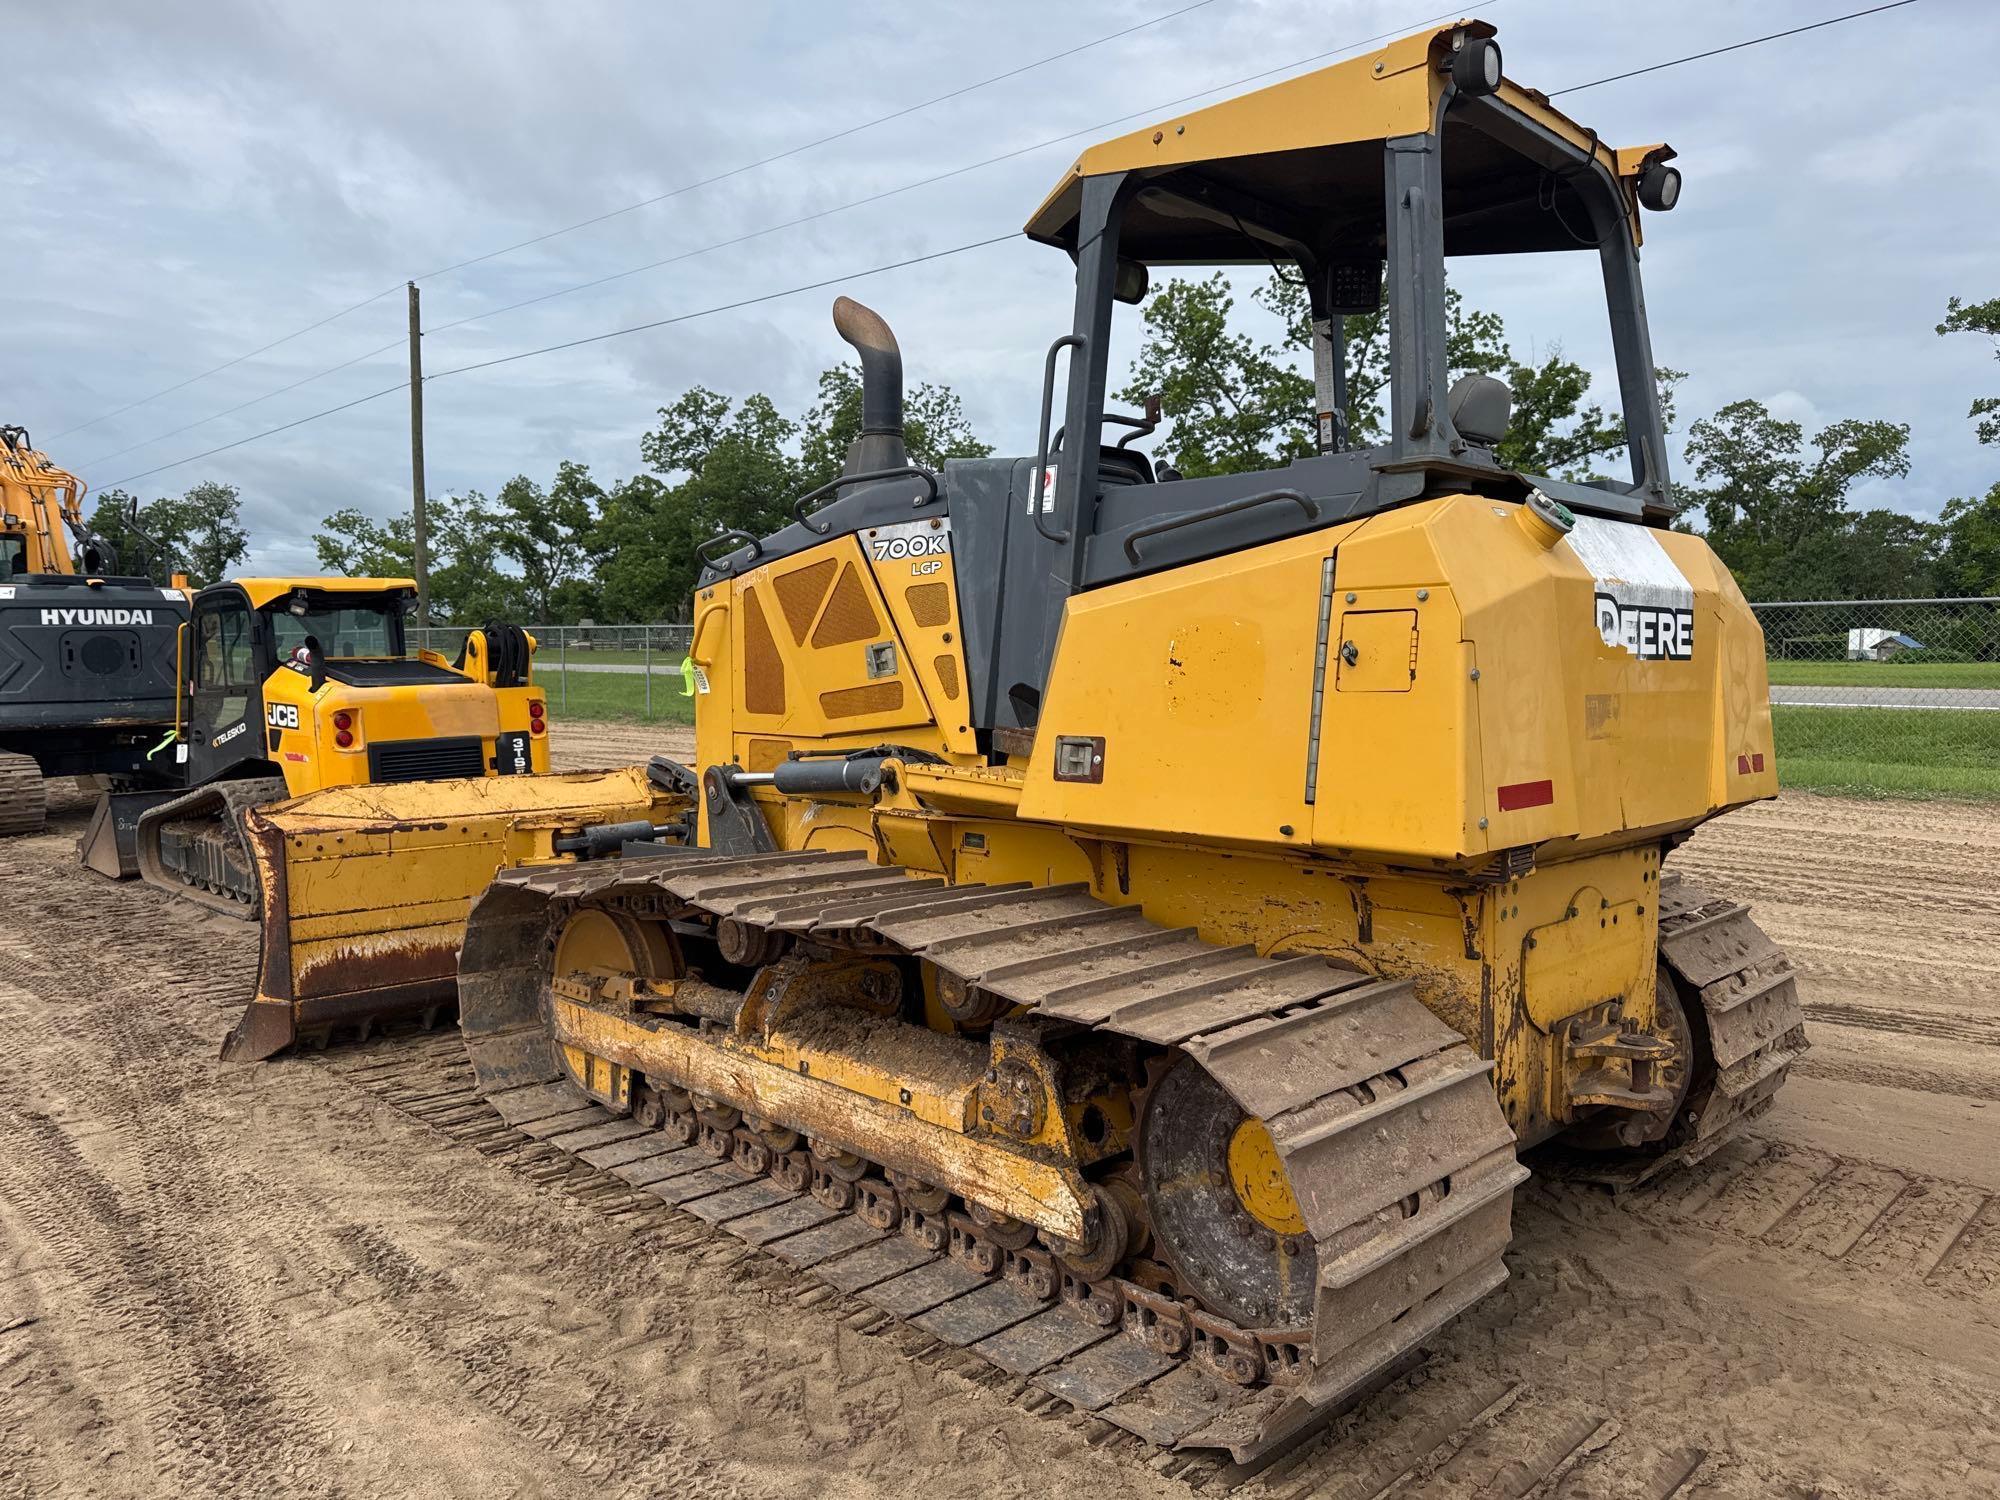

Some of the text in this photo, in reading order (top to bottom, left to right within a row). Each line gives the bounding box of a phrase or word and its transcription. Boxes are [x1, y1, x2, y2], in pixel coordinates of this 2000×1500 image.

[874, 534, 945, 561] 700K
[911, 561, 943, 576] LGP
[40, 609, 153, 625] HYUNDAI
[1595, 596, 1693, 657] DEERE
[267, 704, 298, 728] JCB
[216, 722, 247, 746] TELESKID
[512, 737, 526, 767] 3TS
